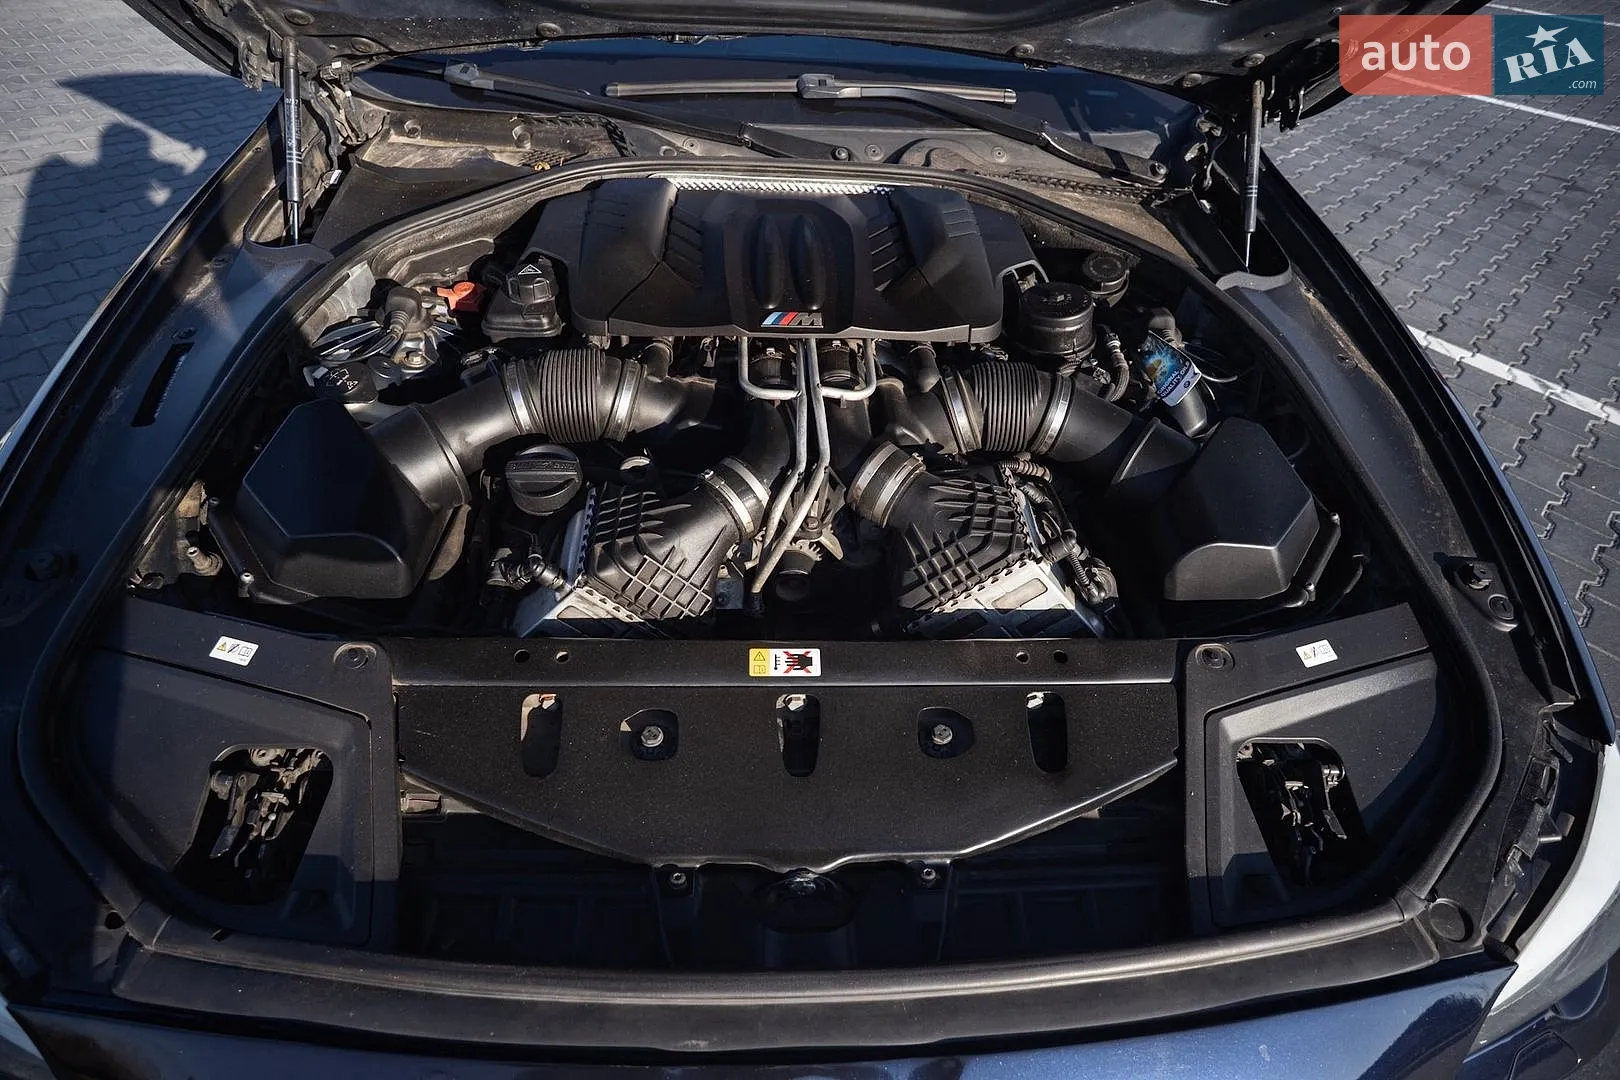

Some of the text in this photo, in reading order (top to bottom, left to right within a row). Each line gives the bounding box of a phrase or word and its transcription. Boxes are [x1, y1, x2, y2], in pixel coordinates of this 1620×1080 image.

[1157, 370, 1180, 394] ORIGINAL
[1160, 361, 1190, 397] QUALITY OILS
